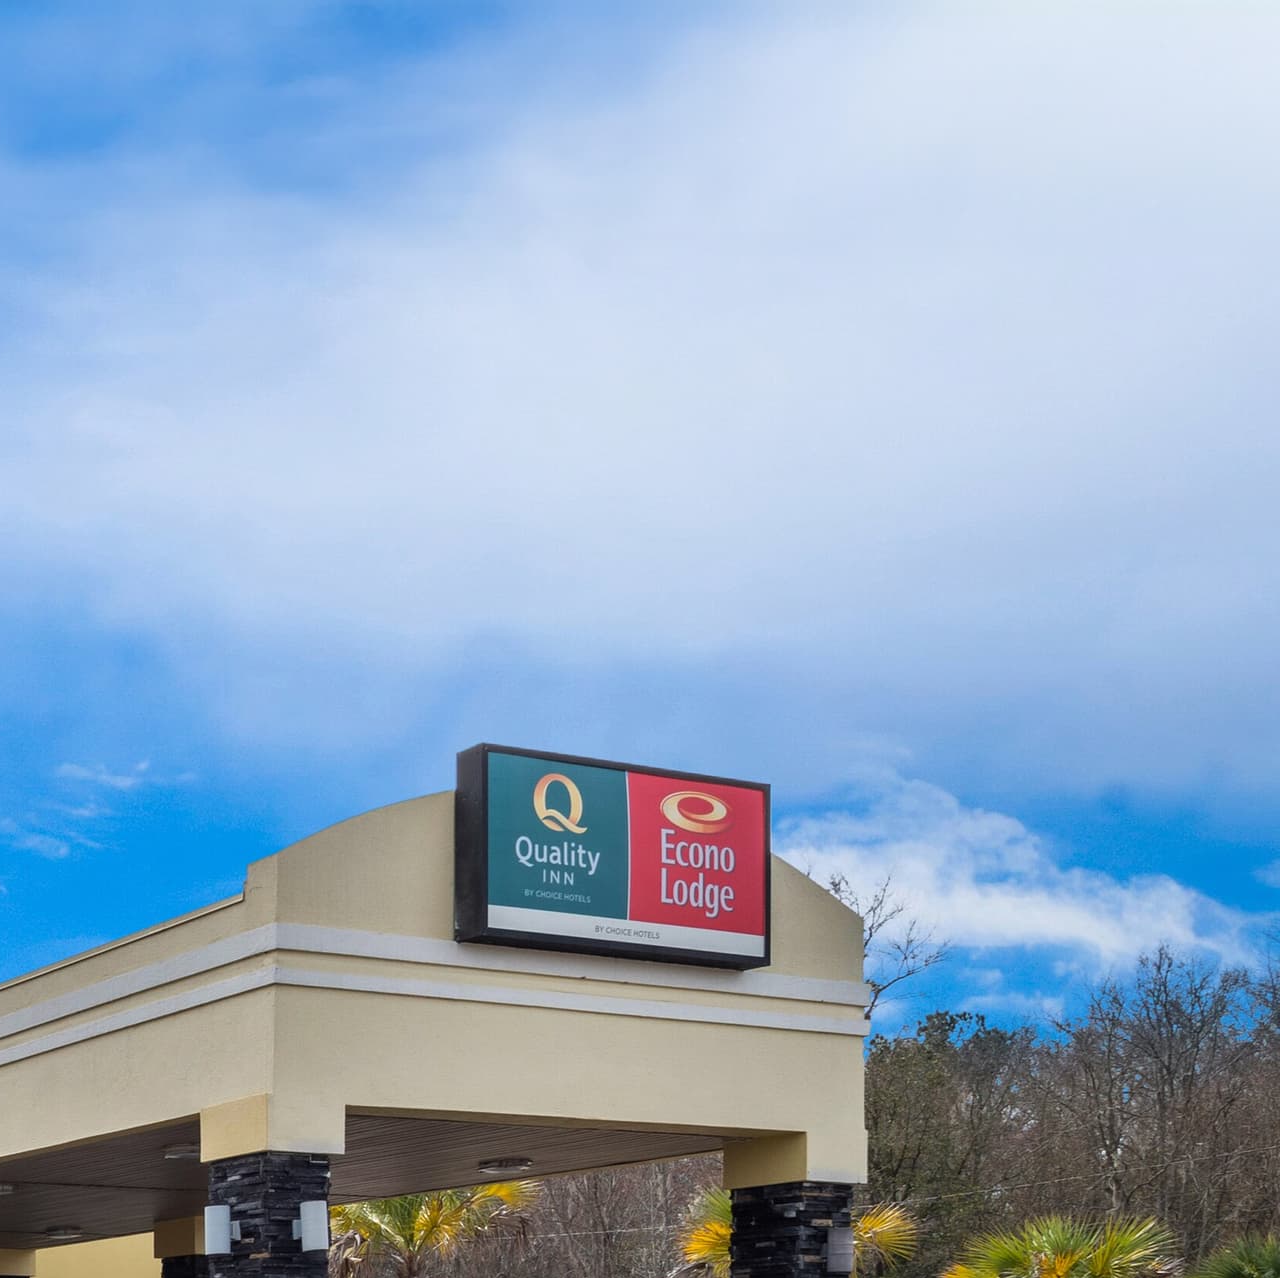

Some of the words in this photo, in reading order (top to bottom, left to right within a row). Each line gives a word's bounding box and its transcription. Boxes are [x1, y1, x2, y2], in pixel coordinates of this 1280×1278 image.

[515, 835, 600, 876] Quality
[660, 828, 735, 873] Econo
[542, 869, 575, 886] INN
[524, 888, 534, 897] BY
[535, 890, 562, 900] CHOICE
[564, 893, 591, 904] HOTELS
[660, 867, 735, 918] Lodge
[594, 925, 605, 933] BY
[605, 926, 632, 937] CHOICE
[633, 930, 660, 940] HOTELS
